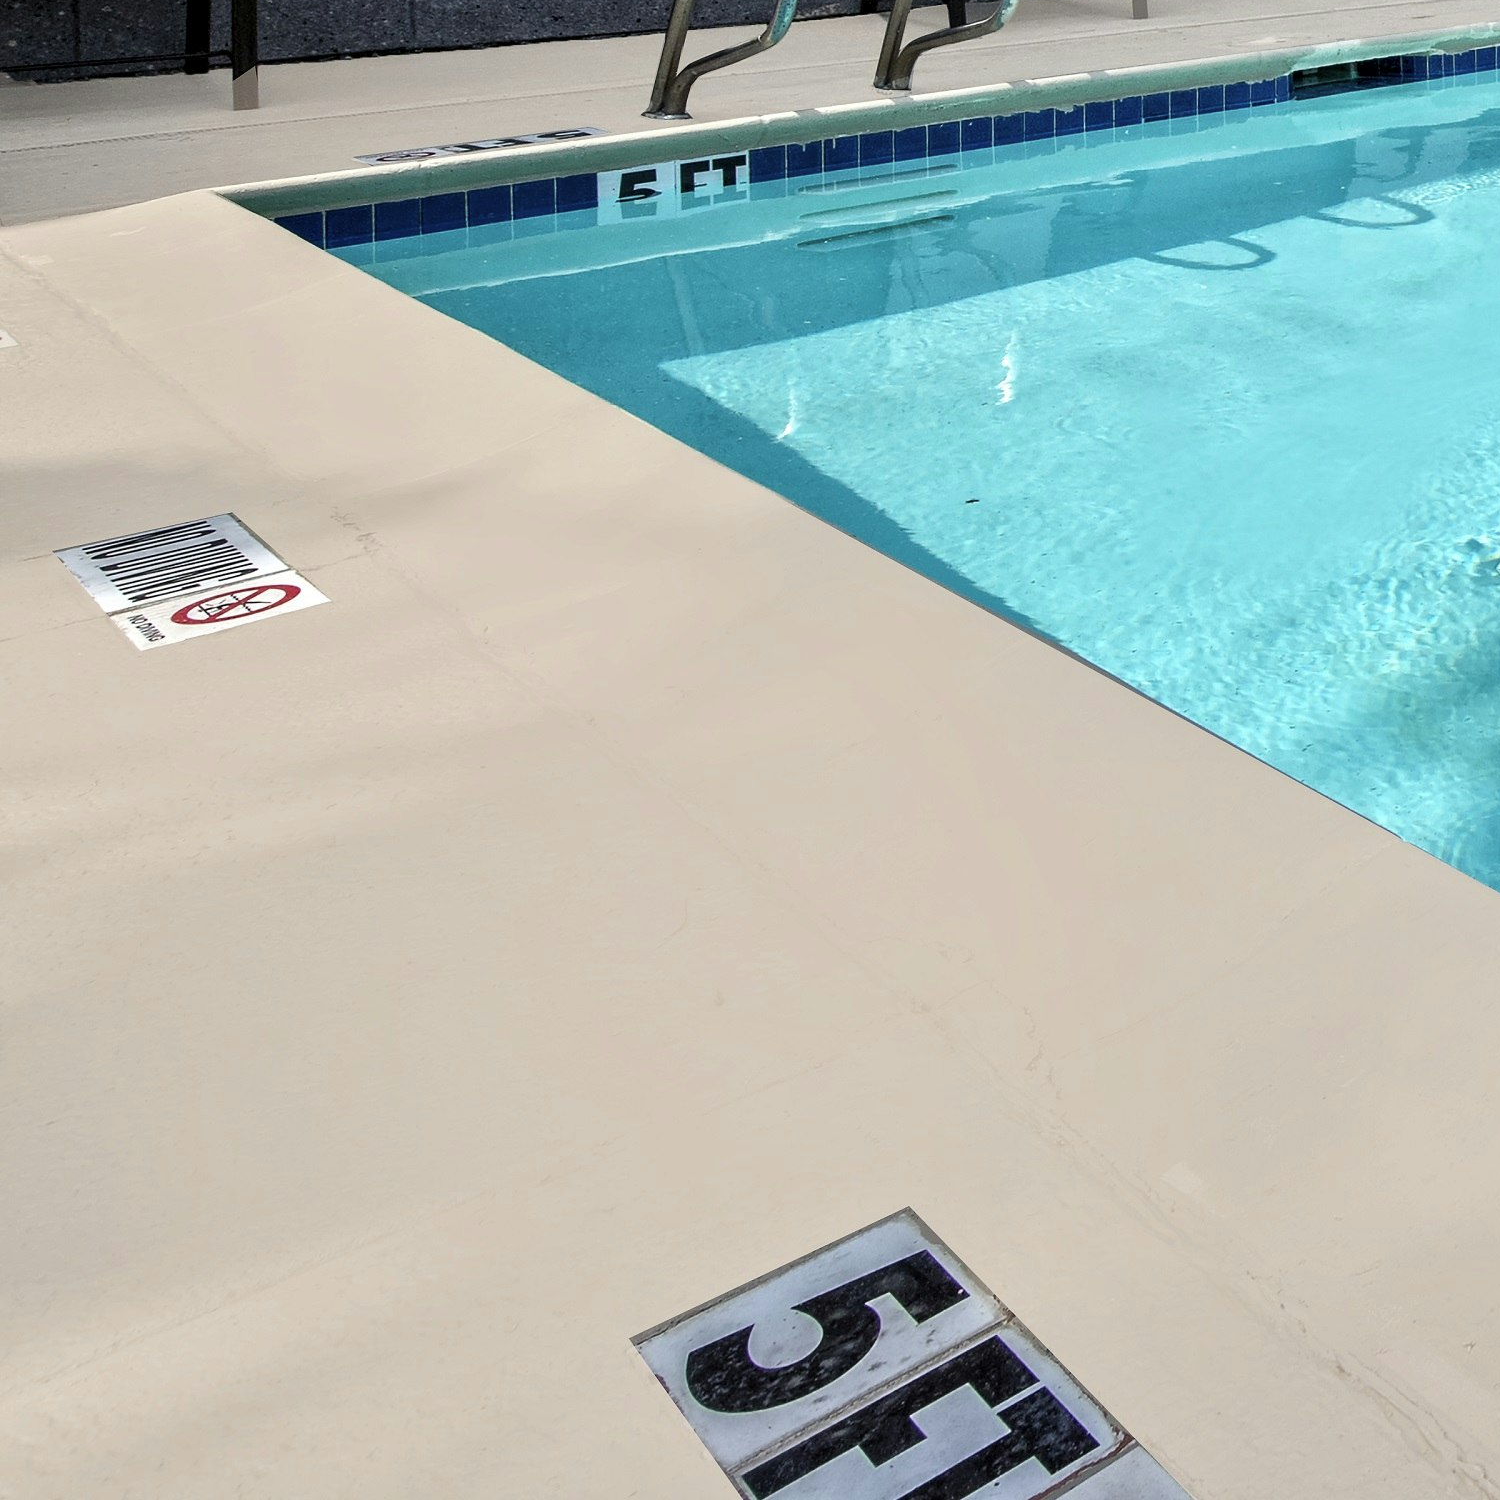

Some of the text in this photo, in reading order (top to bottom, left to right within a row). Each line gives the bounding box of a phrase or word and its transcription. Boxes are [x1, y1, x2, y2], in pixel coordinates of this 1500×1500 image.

[616, 155, 747, 202] 5 FT
[127, 614, 166, 642] NO DIVING
[686, 1249, 971, 1414] 5
